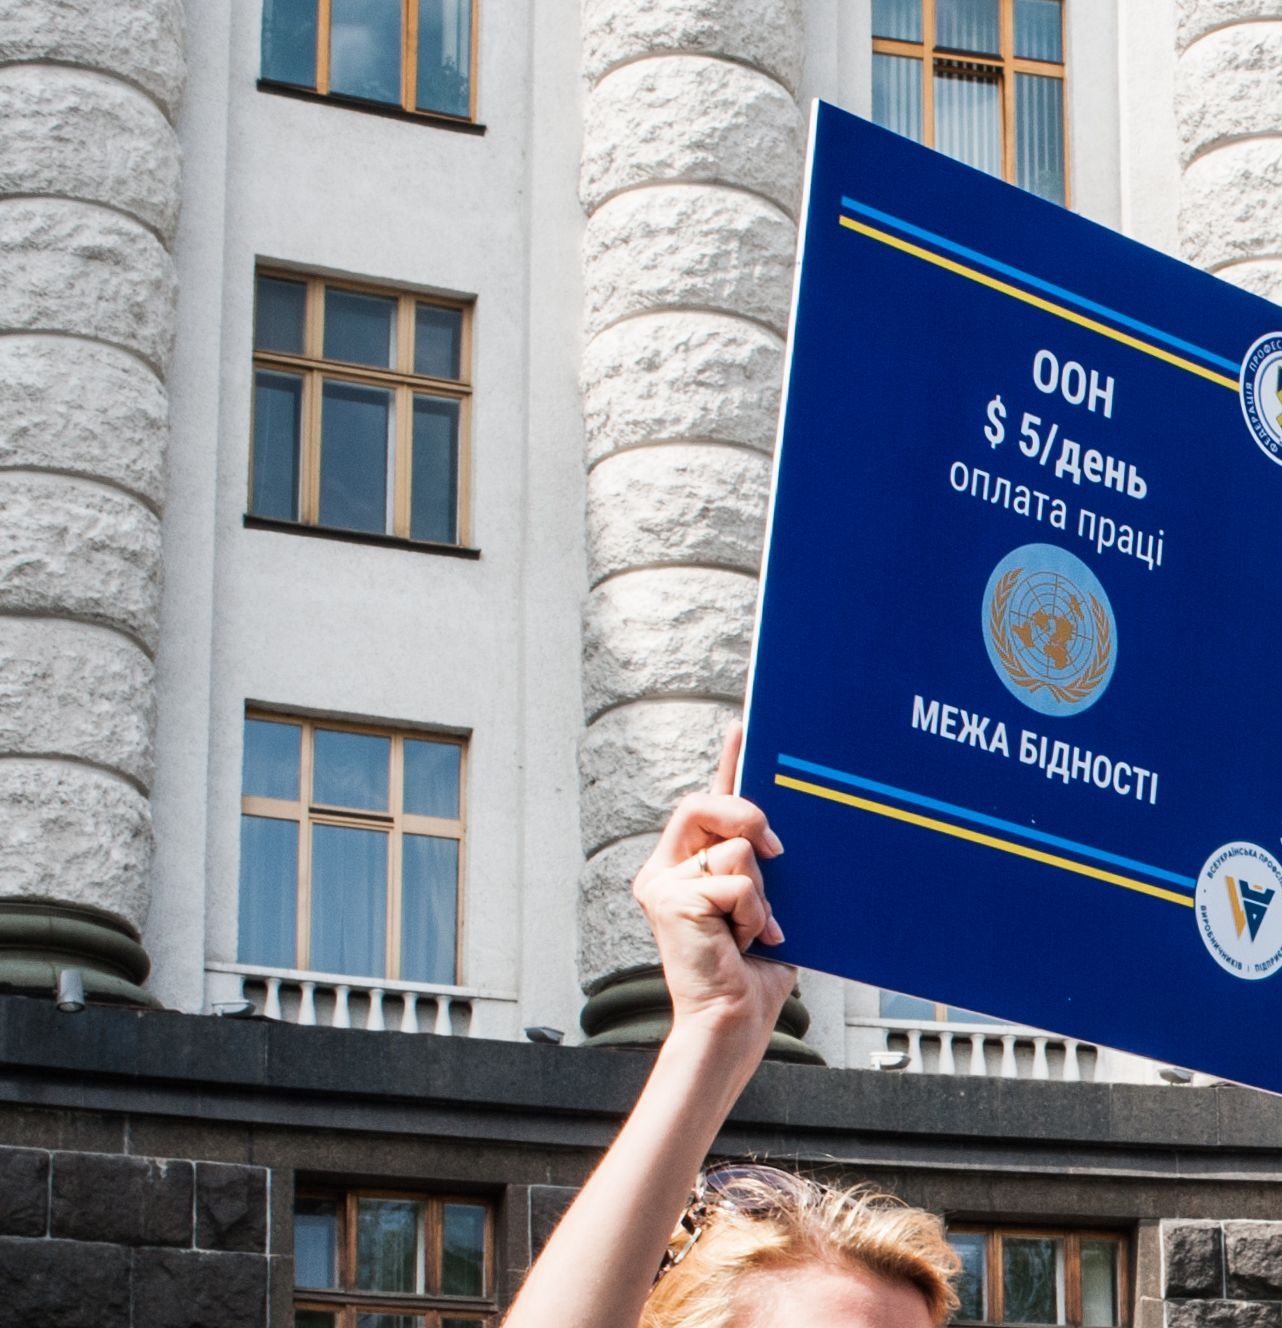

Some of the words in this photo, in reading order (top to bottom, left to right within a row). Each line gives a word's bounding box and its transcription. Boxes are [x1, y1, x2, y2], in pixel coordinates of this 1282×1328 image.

[1033, 349, 1115, 418] ООН
[1244, 381, 1279, 453] ФЕДЕРАЦІЯ
[983, 394, 1007, 449] $
[1018, 412, 1147, 500] 5/день
[950, 461, 1067, 530] оплата
[1078, 509, 1164, 571] праці
[911, 695, 1009, 757] МЕЖА
[1019, 729, 1158, 806] БІДНОСТІ
[1207, 847, 1258, 879] ВСЕУКРАЇНСЬКА
